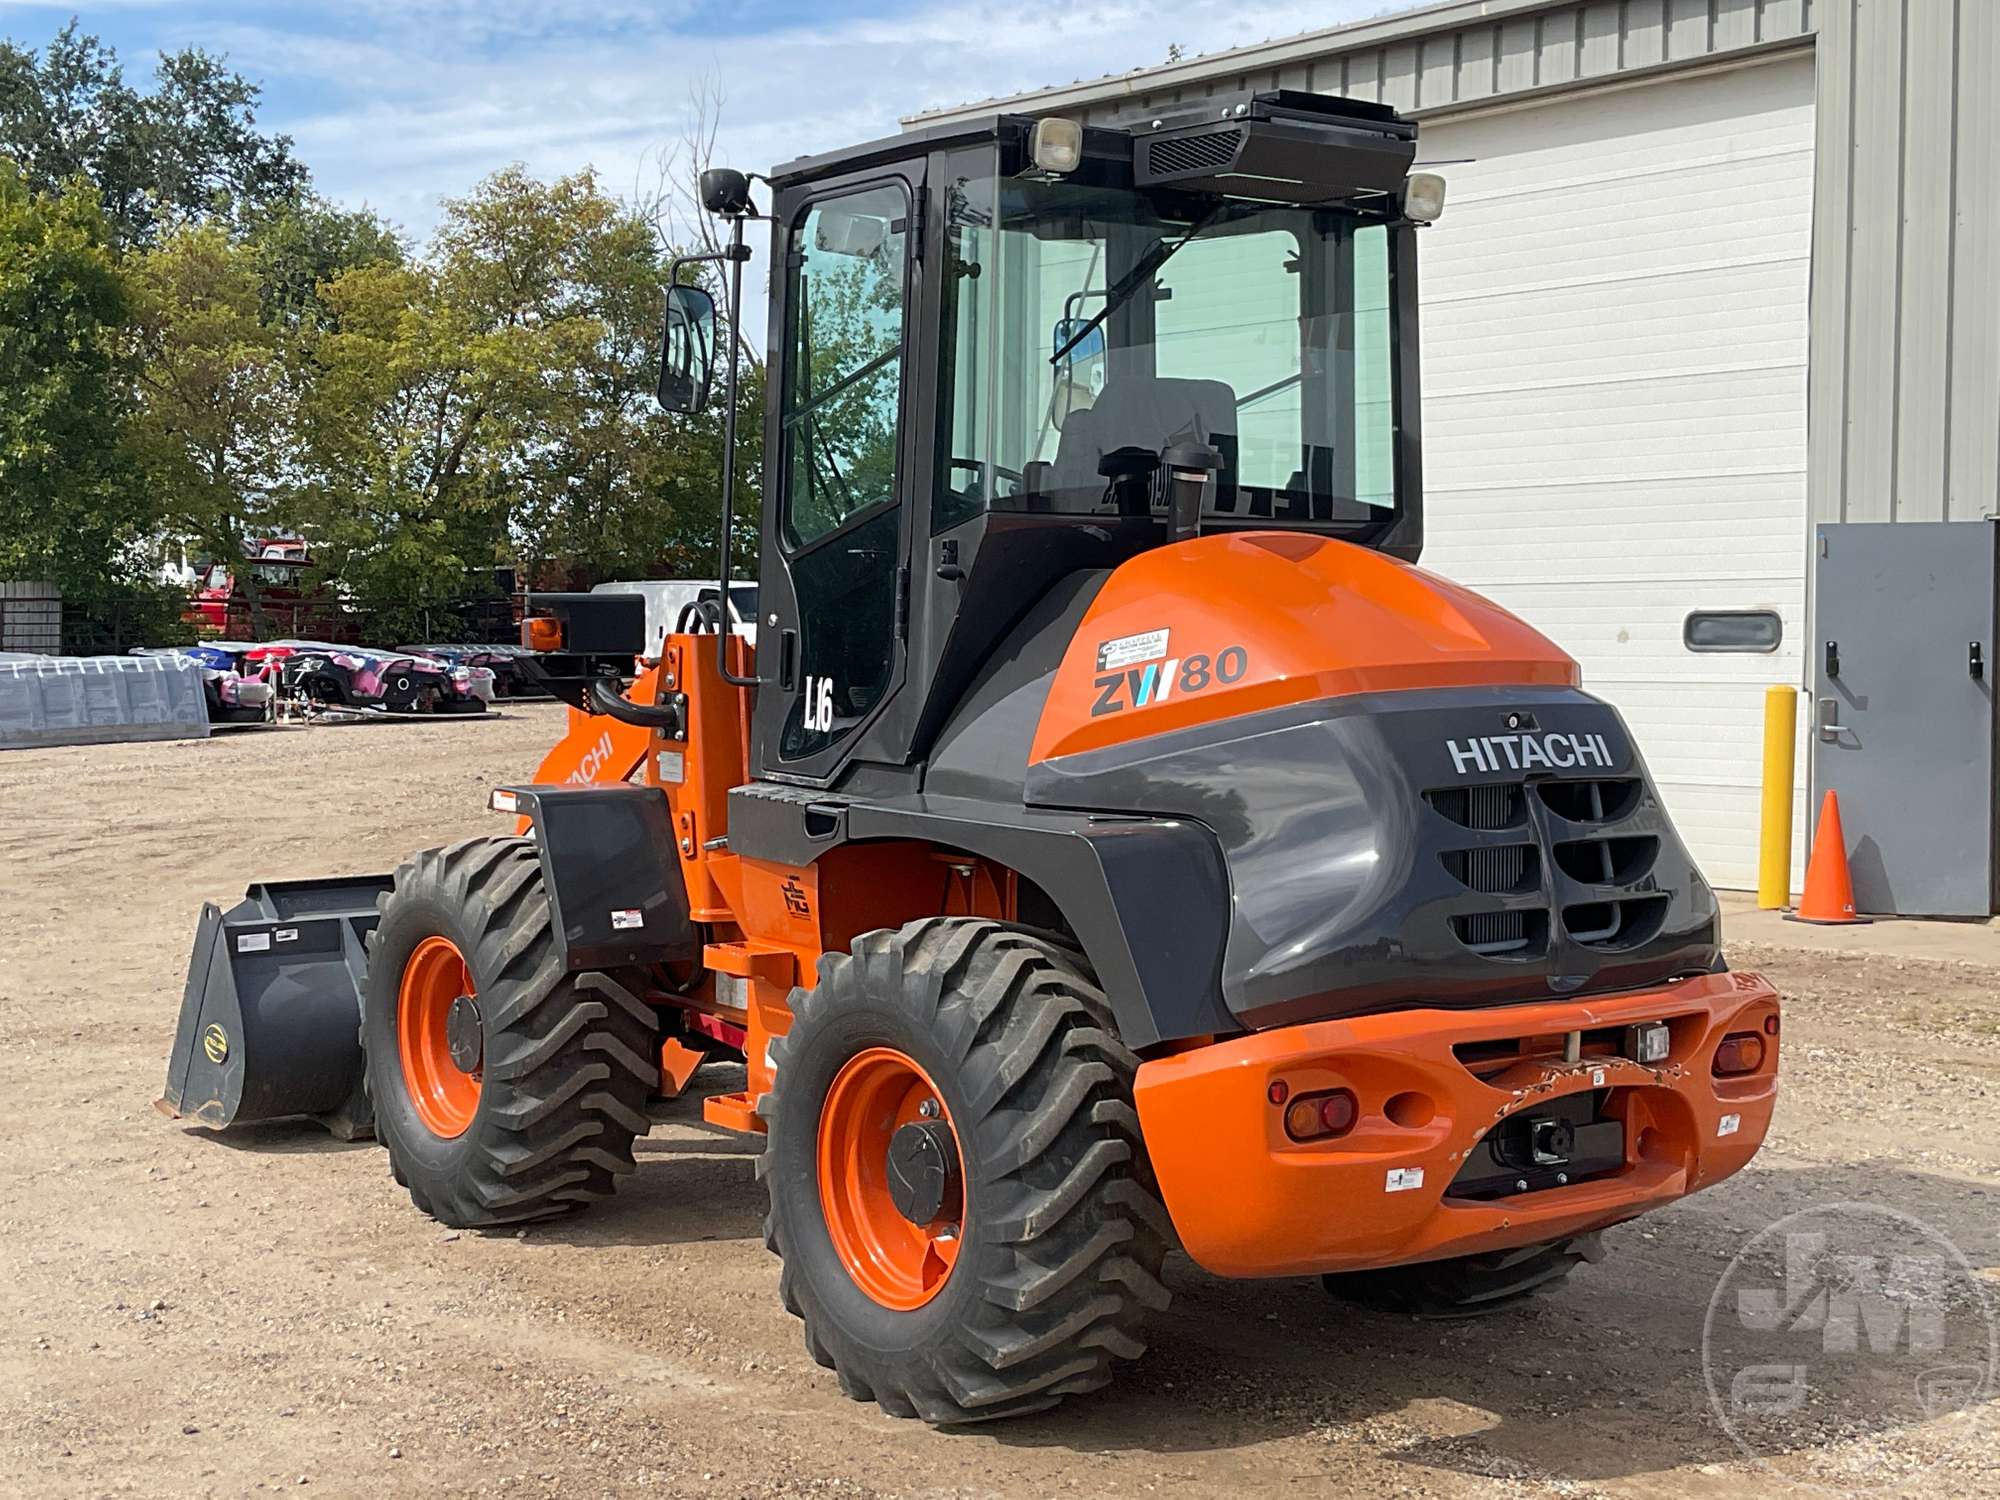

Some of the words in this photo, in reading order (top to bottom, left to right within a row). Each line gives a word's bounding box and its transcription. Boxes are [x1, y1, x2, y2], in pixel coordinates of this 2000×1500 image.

[804, 676, 833, 732] L16
[1091, 646, 1247, 717] ZW80
[565, 731, 613, 785] ACHI
[1446, 733, 1614, 774] HITACHI
